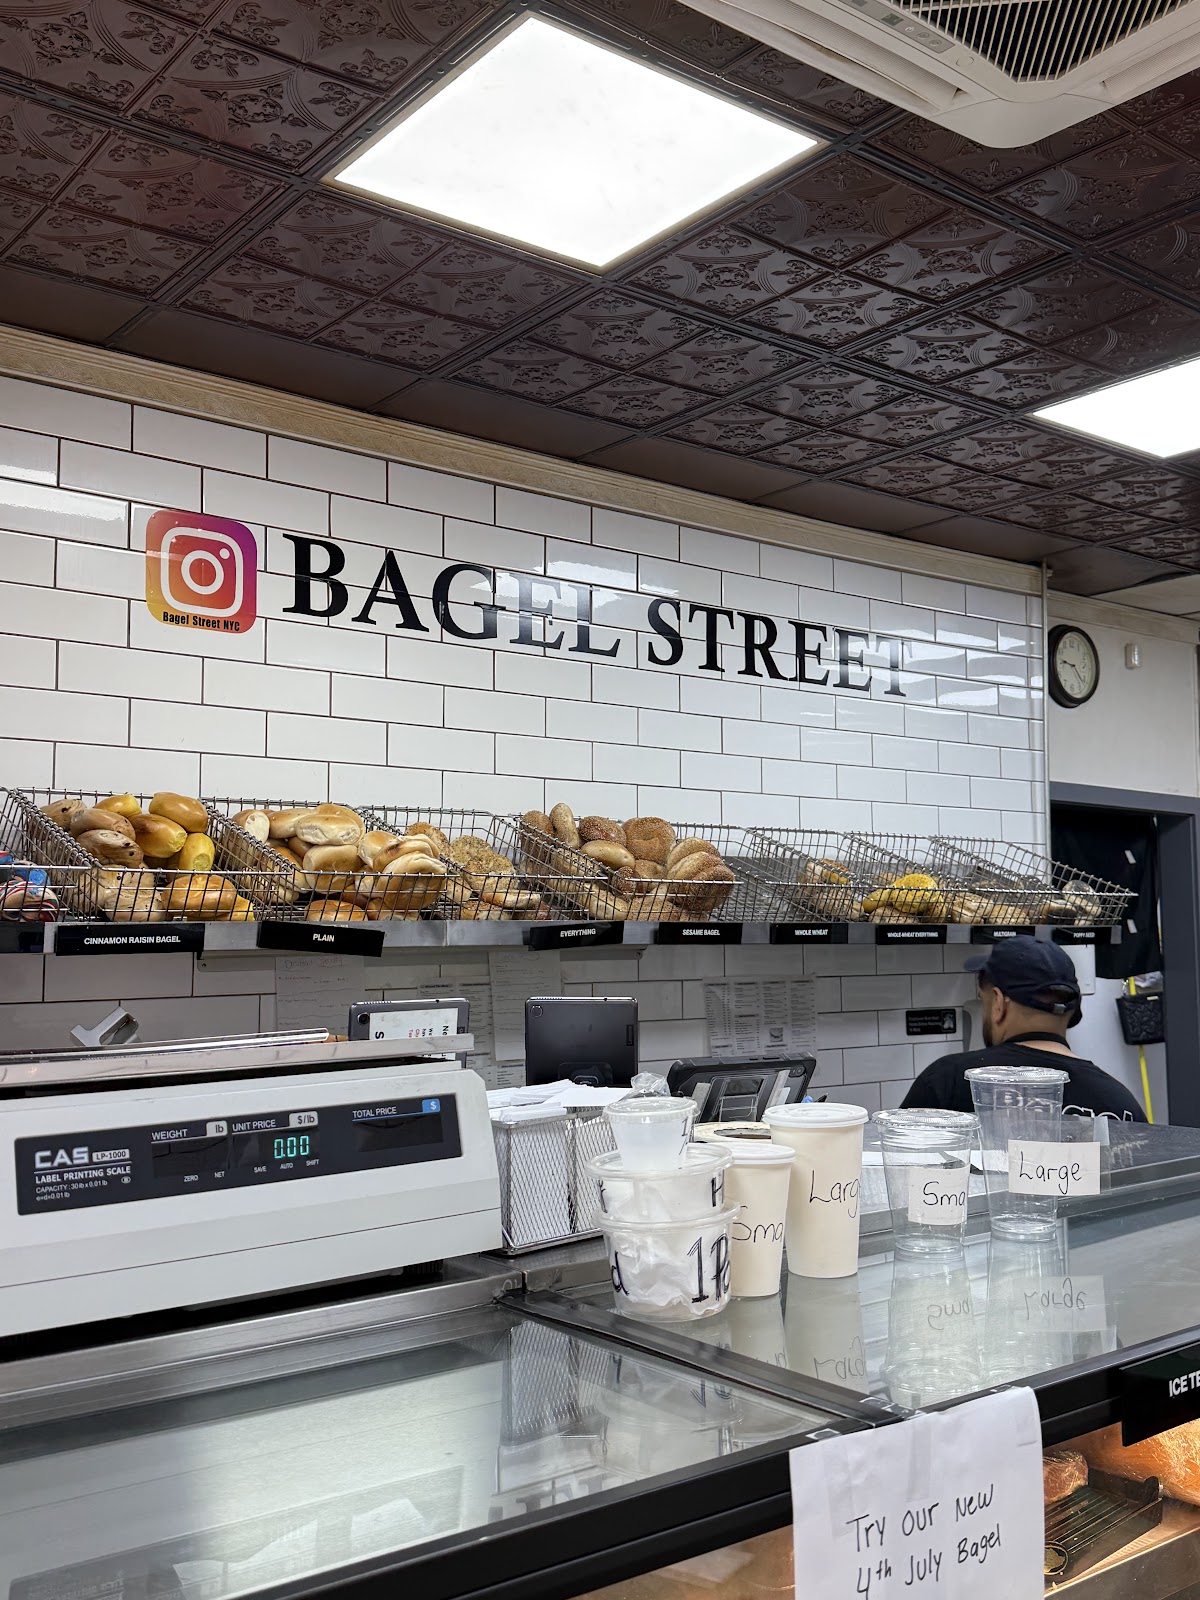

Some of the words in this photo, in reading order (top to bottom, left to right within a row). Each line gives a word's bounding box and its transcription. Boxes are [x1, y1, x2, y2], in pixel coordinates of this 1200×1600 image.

[163, 611, 189, 625] Bagel
[192, 615, 221, 628] Street
[223, 620, 240, 631] NYC
[282, 533, 621, 657] BAGEL
[647, 597, 913, 698] STREET
[313, 933, 335, 942] PLAIN
[560, 928, 596, 938] EVERYTHING
[84, 936, 128, 945] CINNAMON
[129, 936, 154, 944] RAISIN
[155, 935, 181, 943] BAGEL
[430, 1101, 437, 1110] $
[352, 1109, 375, 1119] TOTAL
[376, 1106, 397, 1116] PRICE
[232, 1120, 251, 1131] UNIT
[252, 1118, 276, 1130] PRICE
[297, 1114, 315, 1125] $/lb
[152, 1128, 188, 1141] WEIGHT
[215, 1123, 224, 1133] lb
[274, 1135, 310, 1159] 0.00
[35, 1146, 89, 1169] CAS
[96, 1150, 127, 1161] LP-1000
[253, 1165, 267, 1173] SAVE
[280, 1162, 293, 1170] AUTO
[35, 1174, 61, 1184] LABEL
[63, 1169, 104, 1181] PRINTING
[106, 1166, 131, 1176] SCALE
[184, 1174, 199, 1183] ZERO
[1019, 1151, 1082, 1195] Large
[1169, 1375, 1188, 1397] ICE
[846, 1514, 886, 1552] Try
[857, 1558, 892, 1600] 4th
[905, 1549, 942, 1586] July
[957, 1523, 1001, 1564] Bagel
